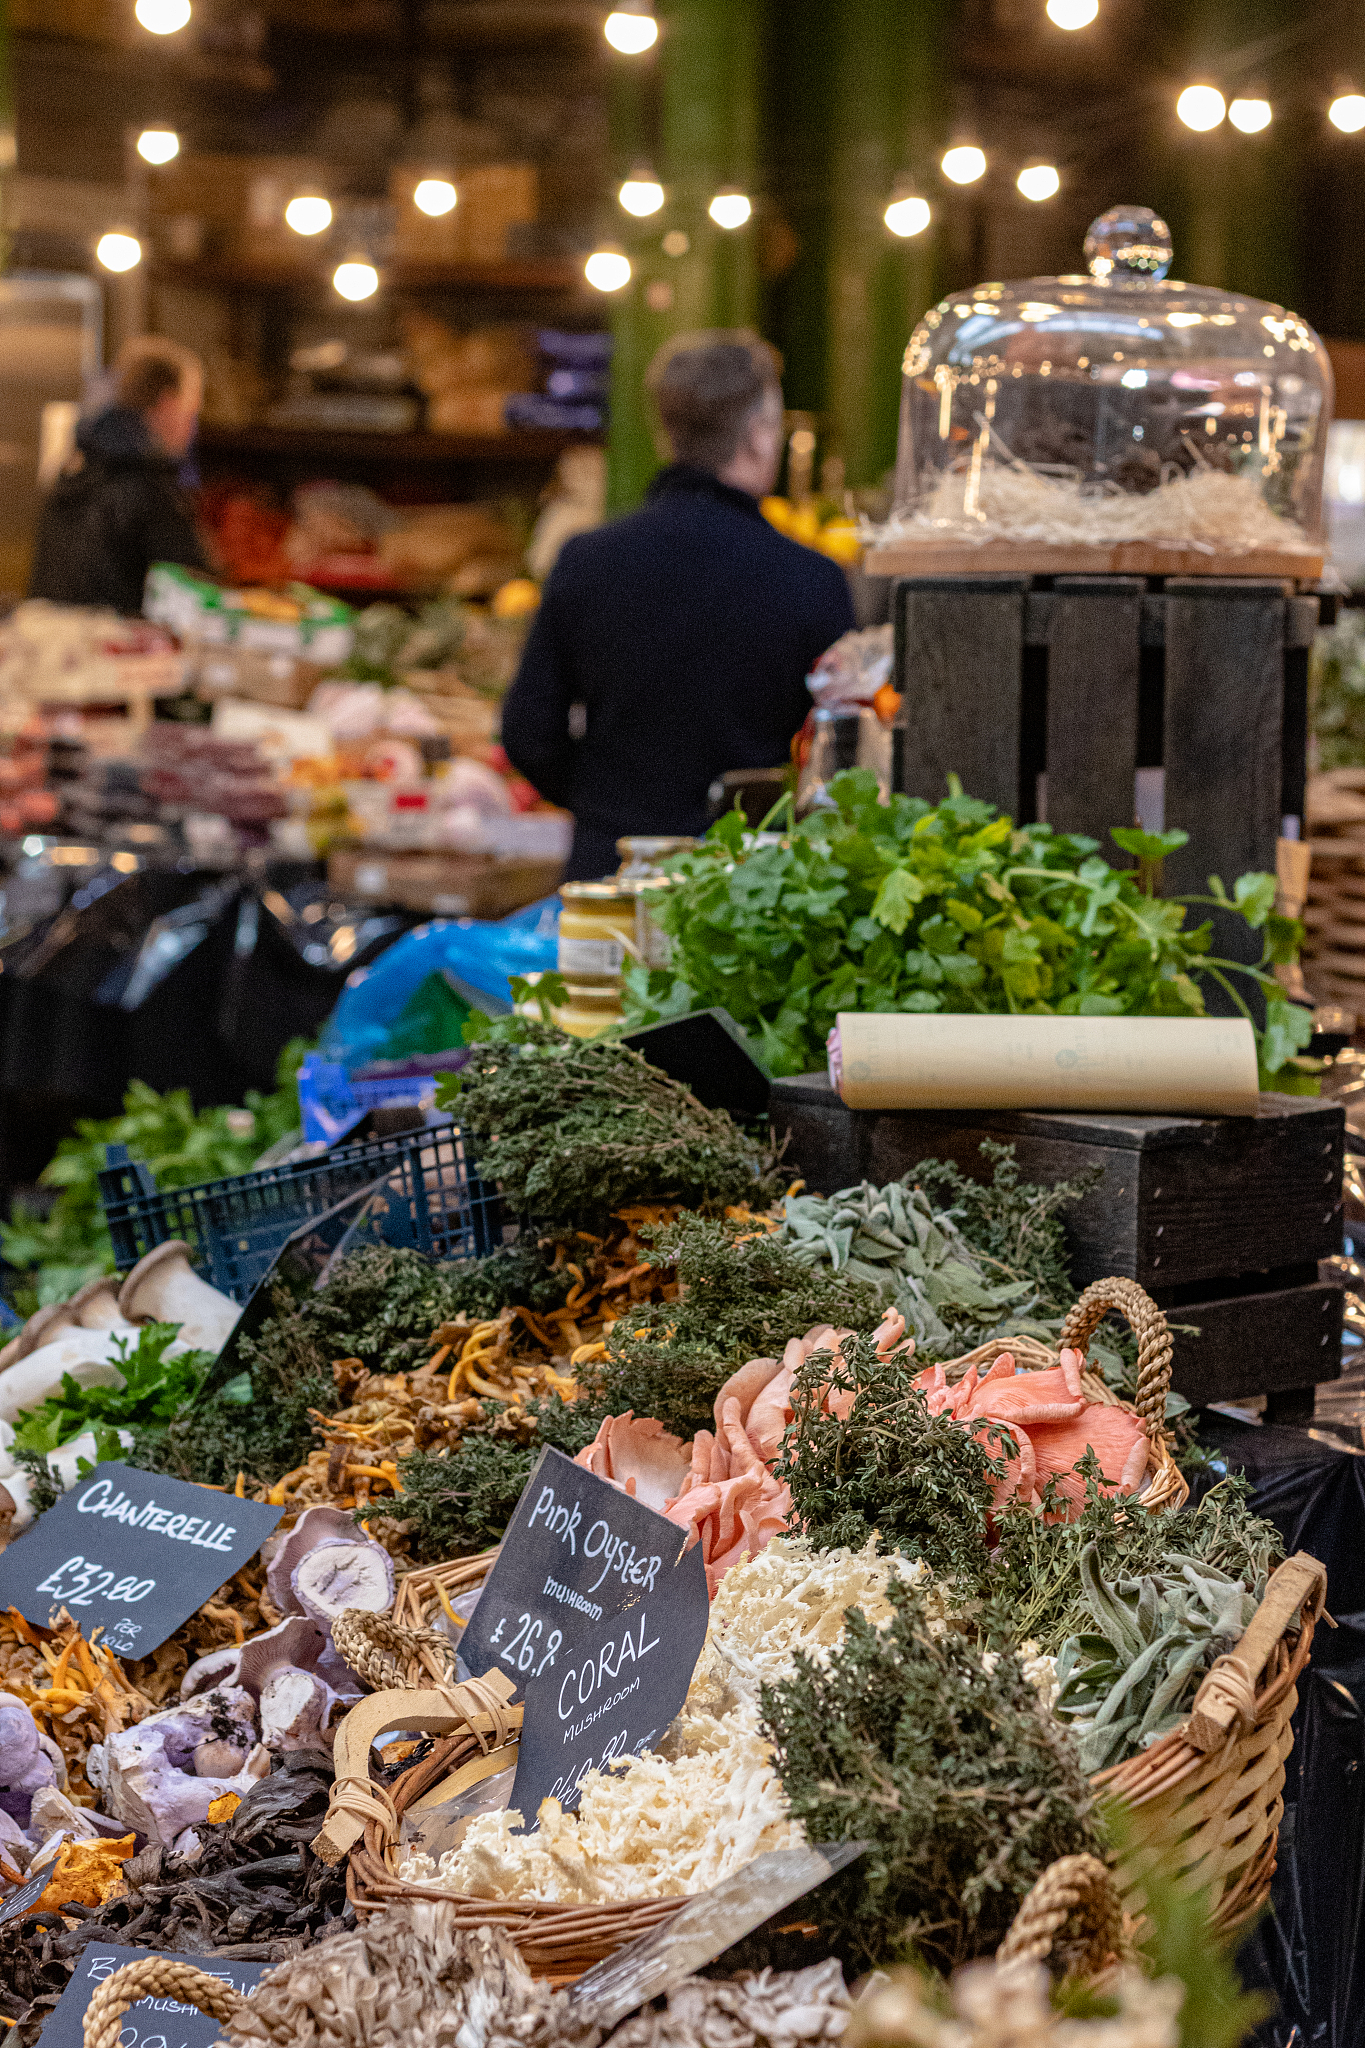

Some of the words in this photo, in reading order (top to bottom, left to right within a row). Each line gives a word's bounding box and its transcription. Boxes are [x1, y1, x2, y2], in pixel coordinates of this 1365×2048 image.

[36, 1555, 156, 1606] £32.80
[557, 1612, 660, 1720] CORAL
[563, 1676, 640, 1744] MUSHROOM
